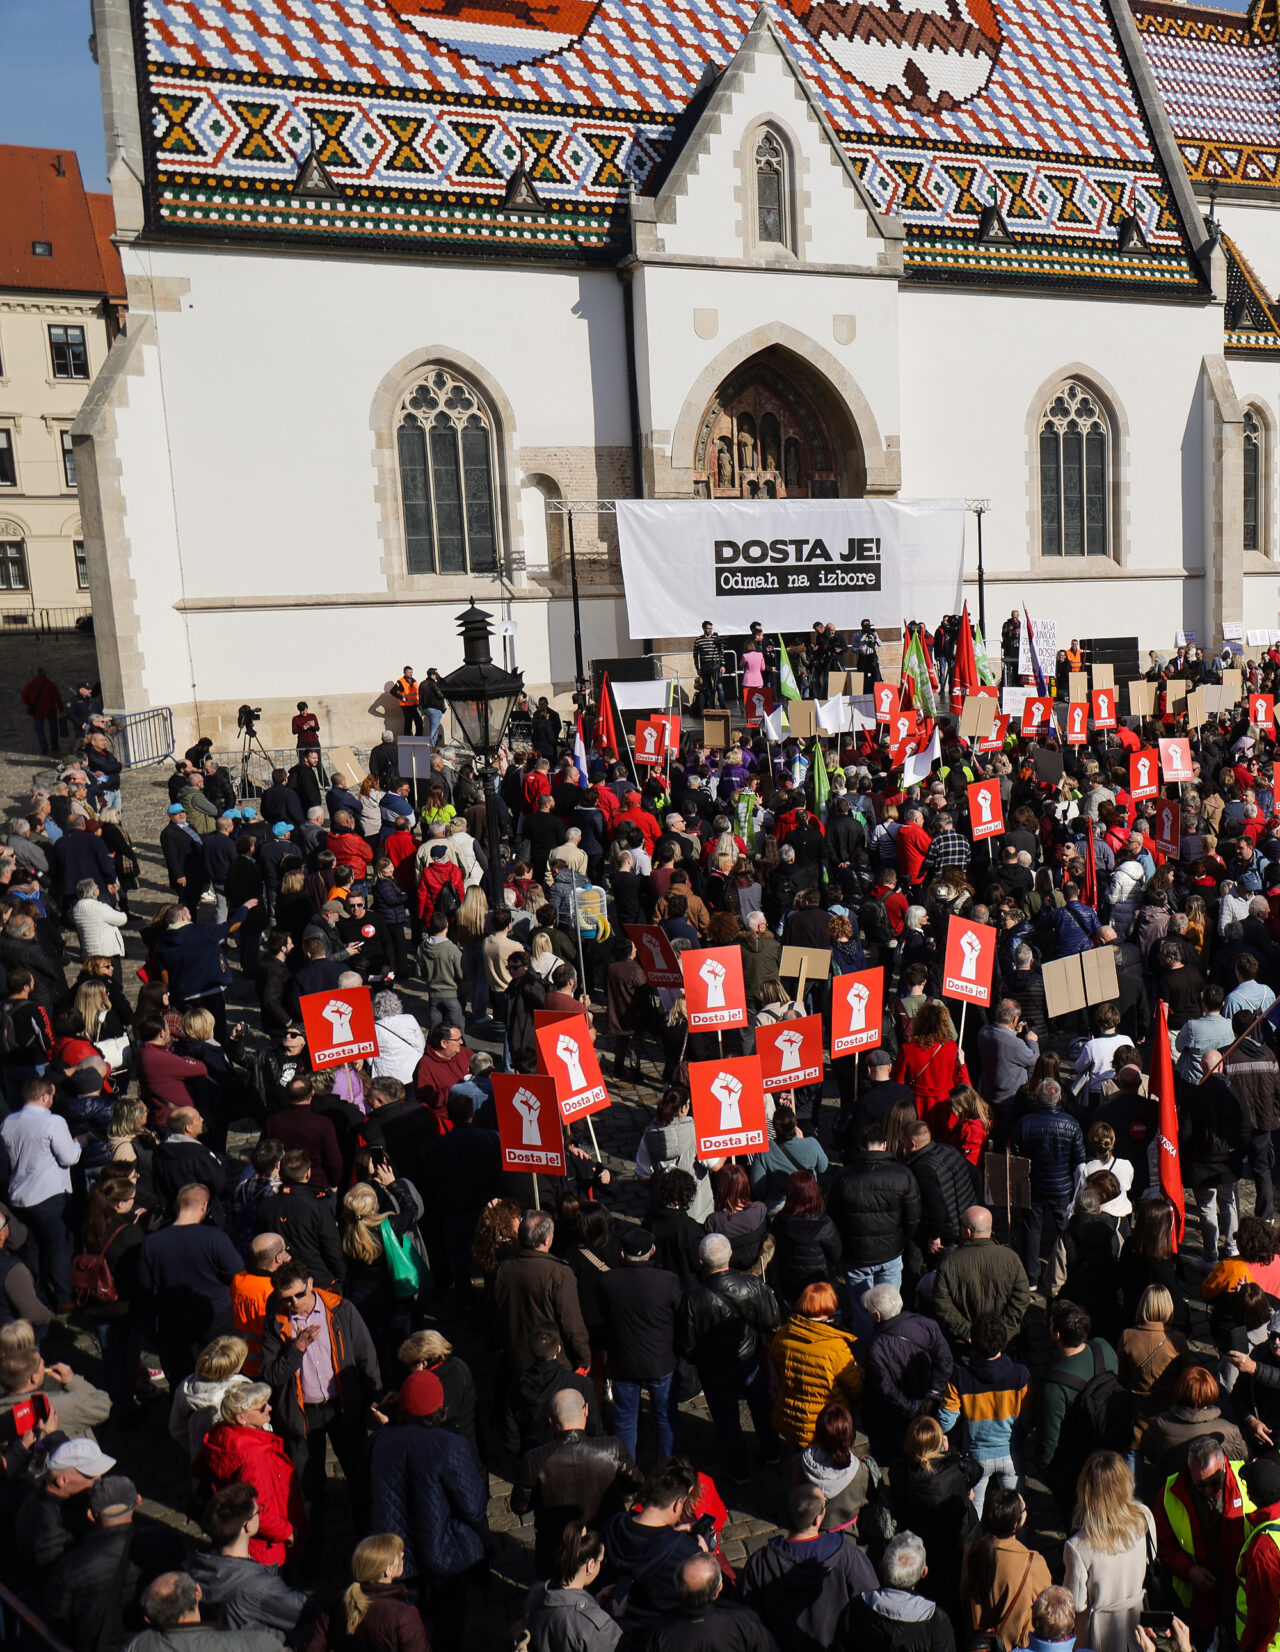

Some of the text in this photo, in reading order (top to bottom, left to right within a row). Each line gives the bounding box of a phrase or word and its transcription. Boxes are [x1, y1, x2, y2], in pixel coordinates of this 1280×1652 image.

[714, 537, 881, 564] DOSTA JE!
[720, 570, 876, 589] Odmah na izbore
[1132, 789, 1148, 797] Dosta
[975, 826, 992, 835] Dosta
[947, 980, 986, 998] Dosta je!
[693, 1010, 741, 1024] Dosta je!
[836, 1031, 877, 1049] Dosta je!
[317, 1043, 372, 1061] Dosta je!
[764, 1068, 818, 1087] Dosta je!
[563, 1088, 604, 1113] Dosta je!
[703, 1132, 761, 1150] Dosta je!
[508, 1151, 560, 1166] Dosta je!
